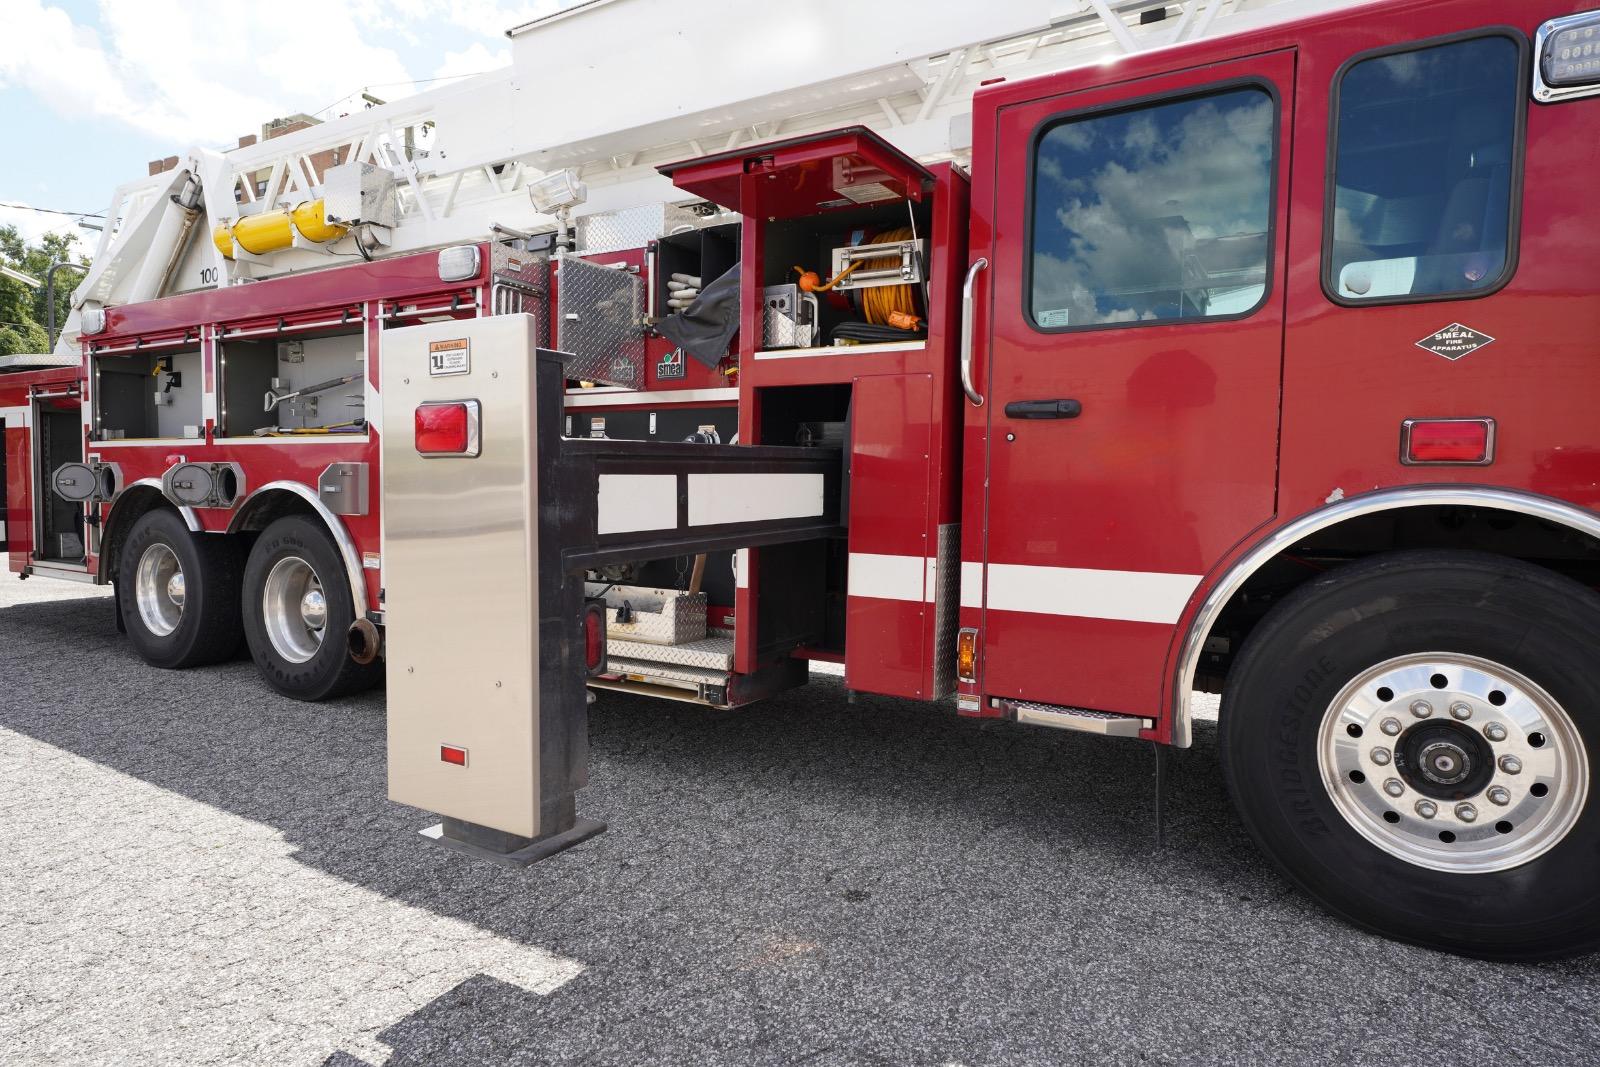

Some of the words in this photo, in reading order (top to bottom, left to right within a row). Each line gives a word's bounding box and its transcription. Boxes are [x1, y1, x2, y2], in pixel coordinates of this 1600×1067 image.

[200, 267, 219, 284] 100
[1434, 331, 1474, 340] SMEAL
[1431, 343, 1478, 351] APPARATUS
[1279, 655, 1338, 836] BRIDGESTONE
